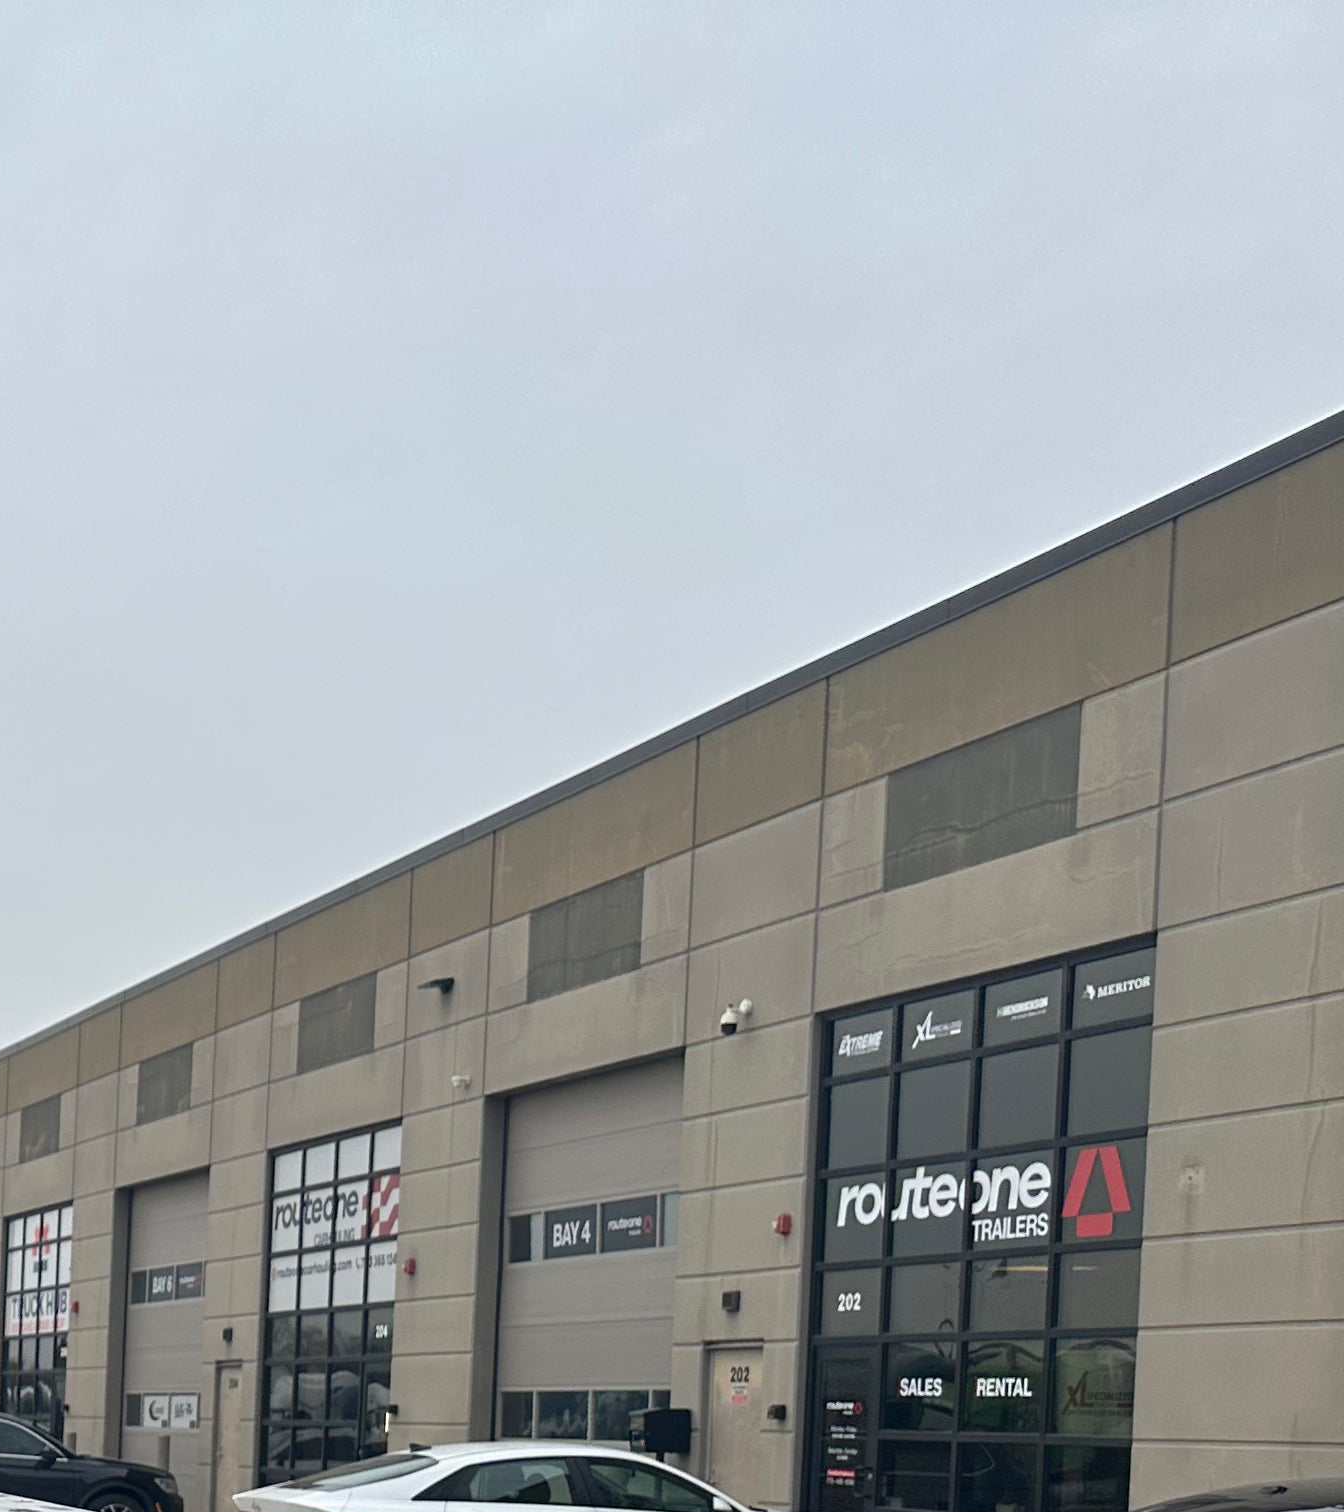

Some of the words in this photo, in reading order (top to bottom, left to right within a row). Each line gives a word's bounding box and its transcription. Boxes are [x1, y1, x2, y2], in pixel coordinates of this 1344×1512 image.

[1097, 975, 1151, 998] MERITOR
[837, 1161, 1052, 1227] routeone
[552, 1222, 579, 1248] BAY
[581, 1219, 591, 1244] 4
[972, 1213, 1049, 1242] TRAILERS
[838, 1292, 861, 1312] 202
[730, 1366, 750, 1383] 202
[899, 1377, 943, 1397] SALES
[976, 1377, 1032, 1398] RENTAL
